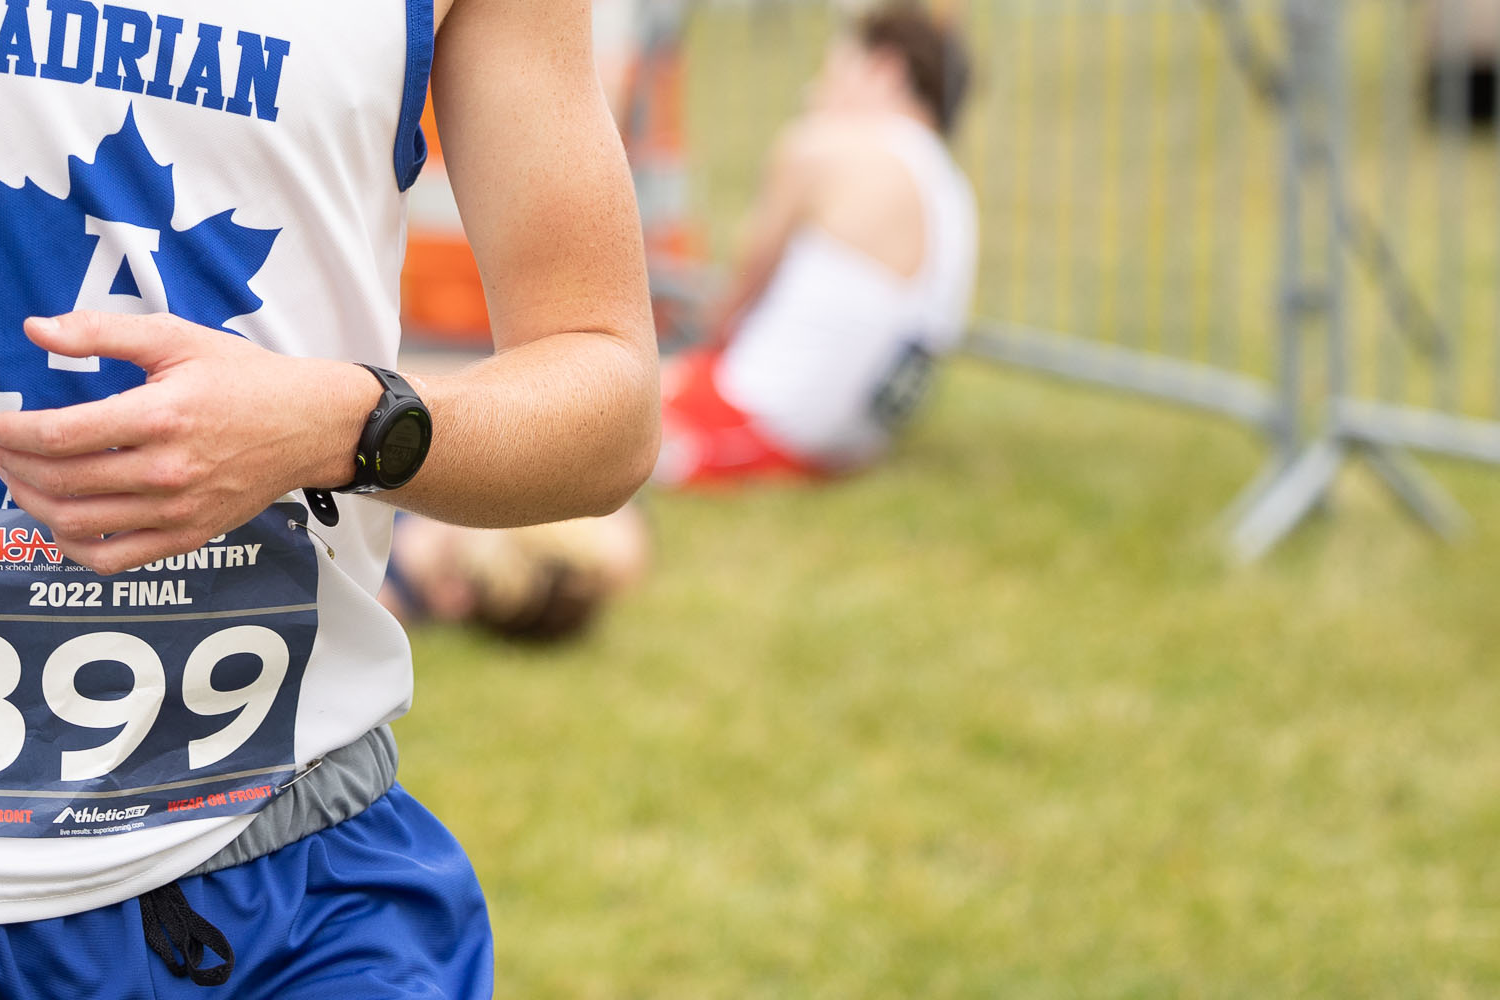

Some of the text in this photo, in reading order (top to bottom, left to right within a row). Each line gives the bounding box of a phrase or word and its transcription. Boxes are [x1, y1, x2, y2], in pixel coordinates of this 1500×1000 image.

[48, 213, 170, 373] A
[5, 562, 31, 572] school
[33, 562, 62, 572] athletic
[125, 543, 262, 572] OUNTRY
[29, 579, 193, 607] 2022 FINAL
[167, 785, 272, 812] WEAR ON FRONT
